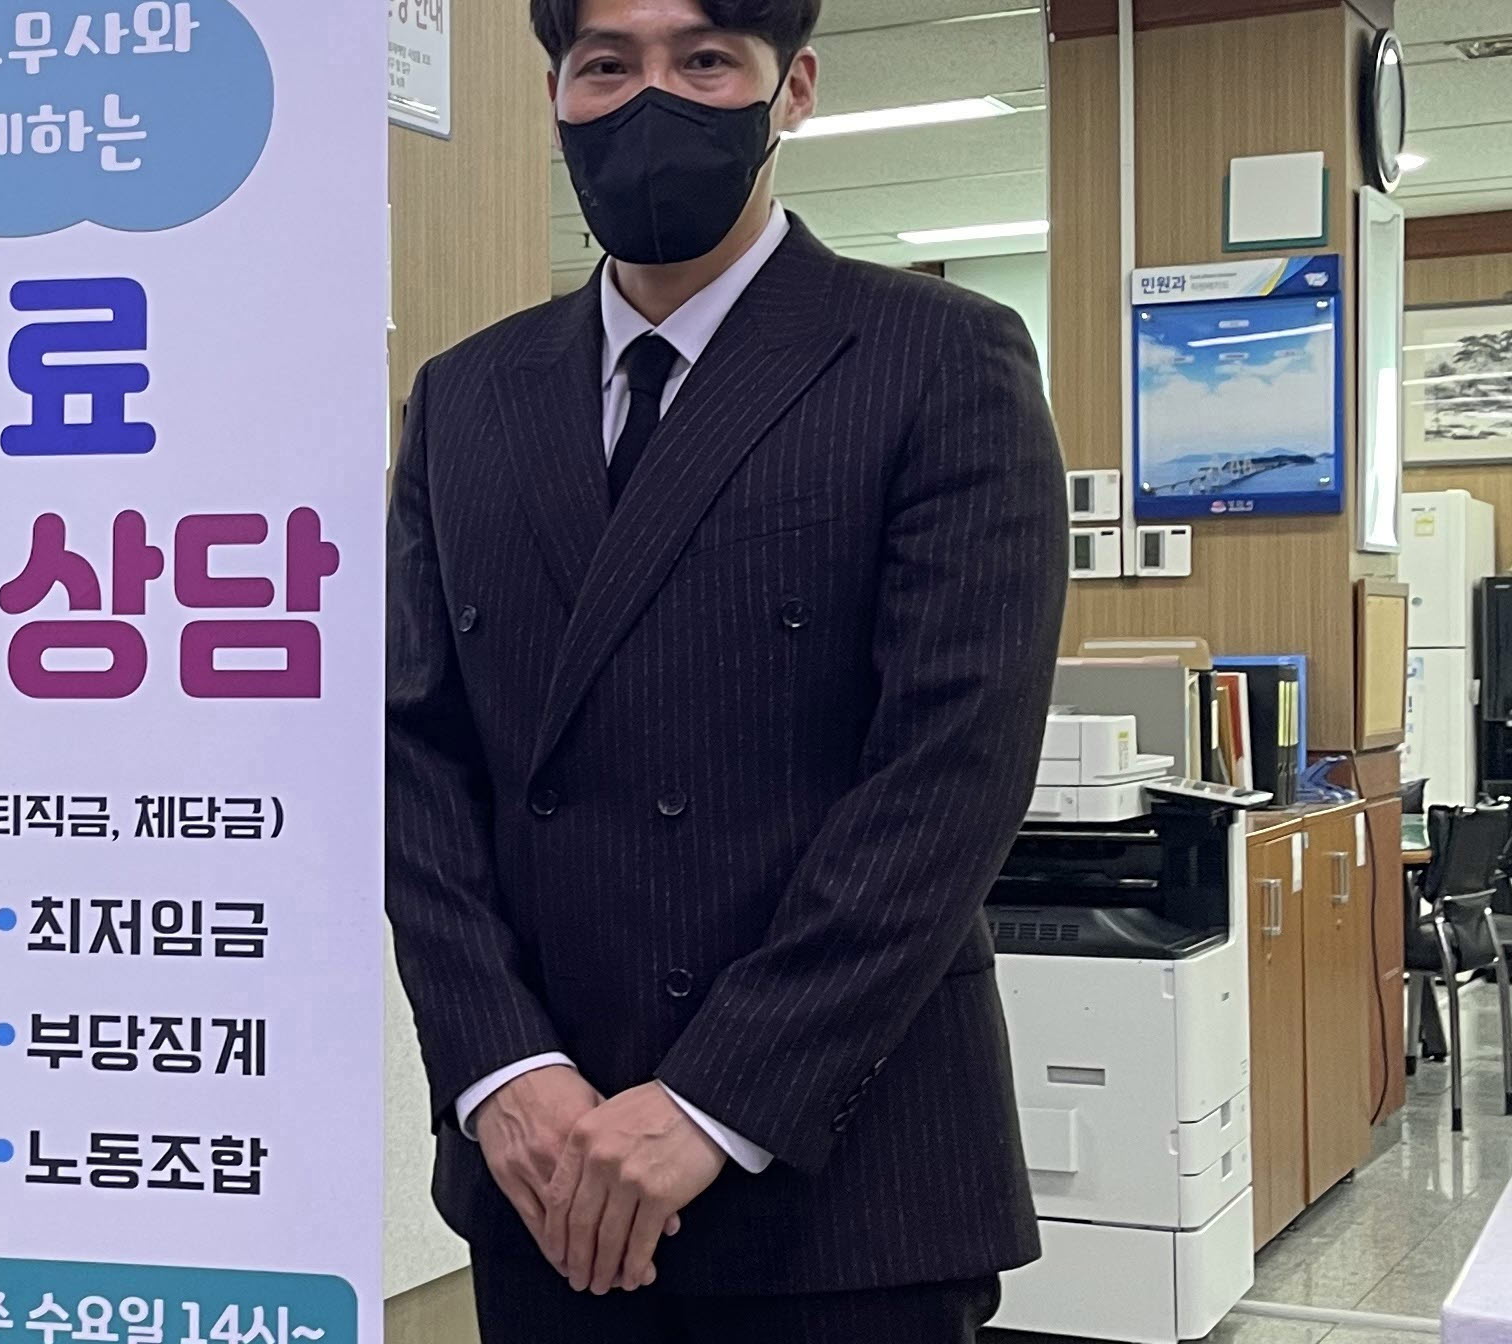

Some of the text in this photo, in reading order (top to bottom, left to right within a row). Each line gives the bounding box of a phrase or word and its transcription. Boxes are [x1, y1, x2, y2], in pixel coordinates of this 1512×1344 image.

[1141, 274, 1186, 294] 민원과
[135, 795, 284, 840] 체당금)
[28, 897, 269, 959] 최저임금
[27, 1014, 266, 1076] 부당징계
[26, 1131, 268, 1195] 노동조합
